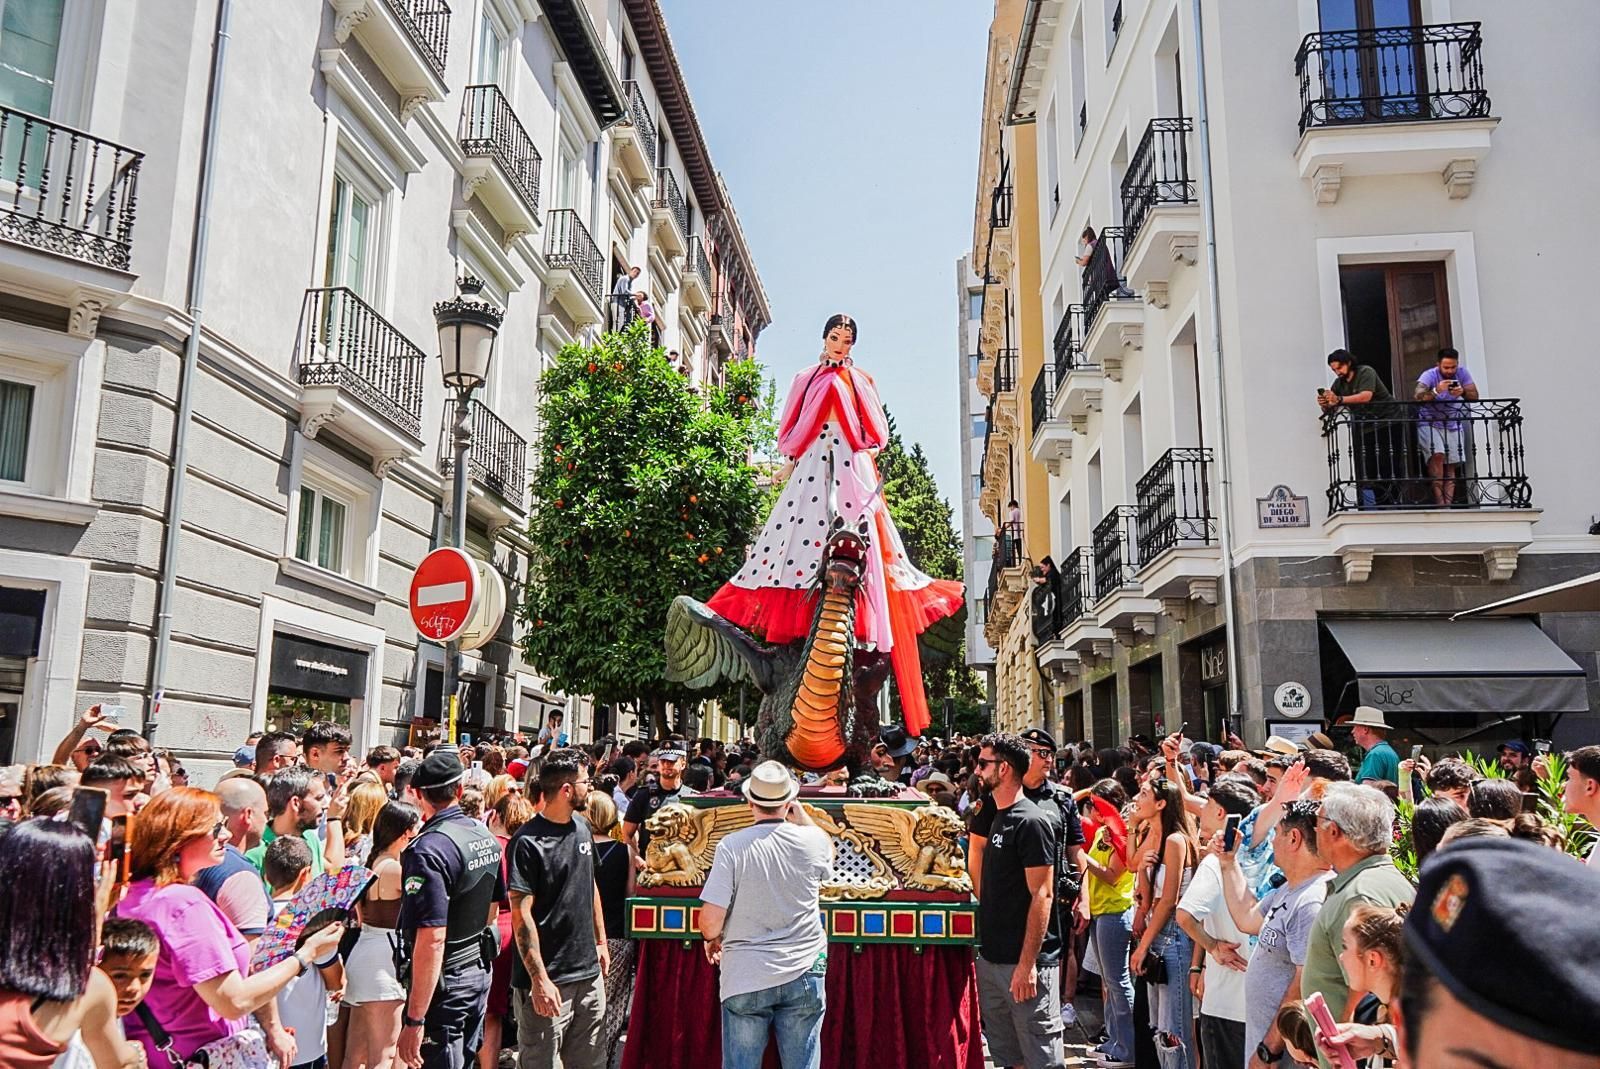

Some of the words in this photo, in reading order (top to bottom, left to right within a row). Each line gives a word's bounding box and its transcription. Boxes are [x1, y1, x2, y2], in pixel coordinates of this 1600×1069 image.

[1270, 508, 1294, 516] DIEGO
[1263, 516, 1273, 524] DE
[1277, 515, 1300, 523] SILOE
